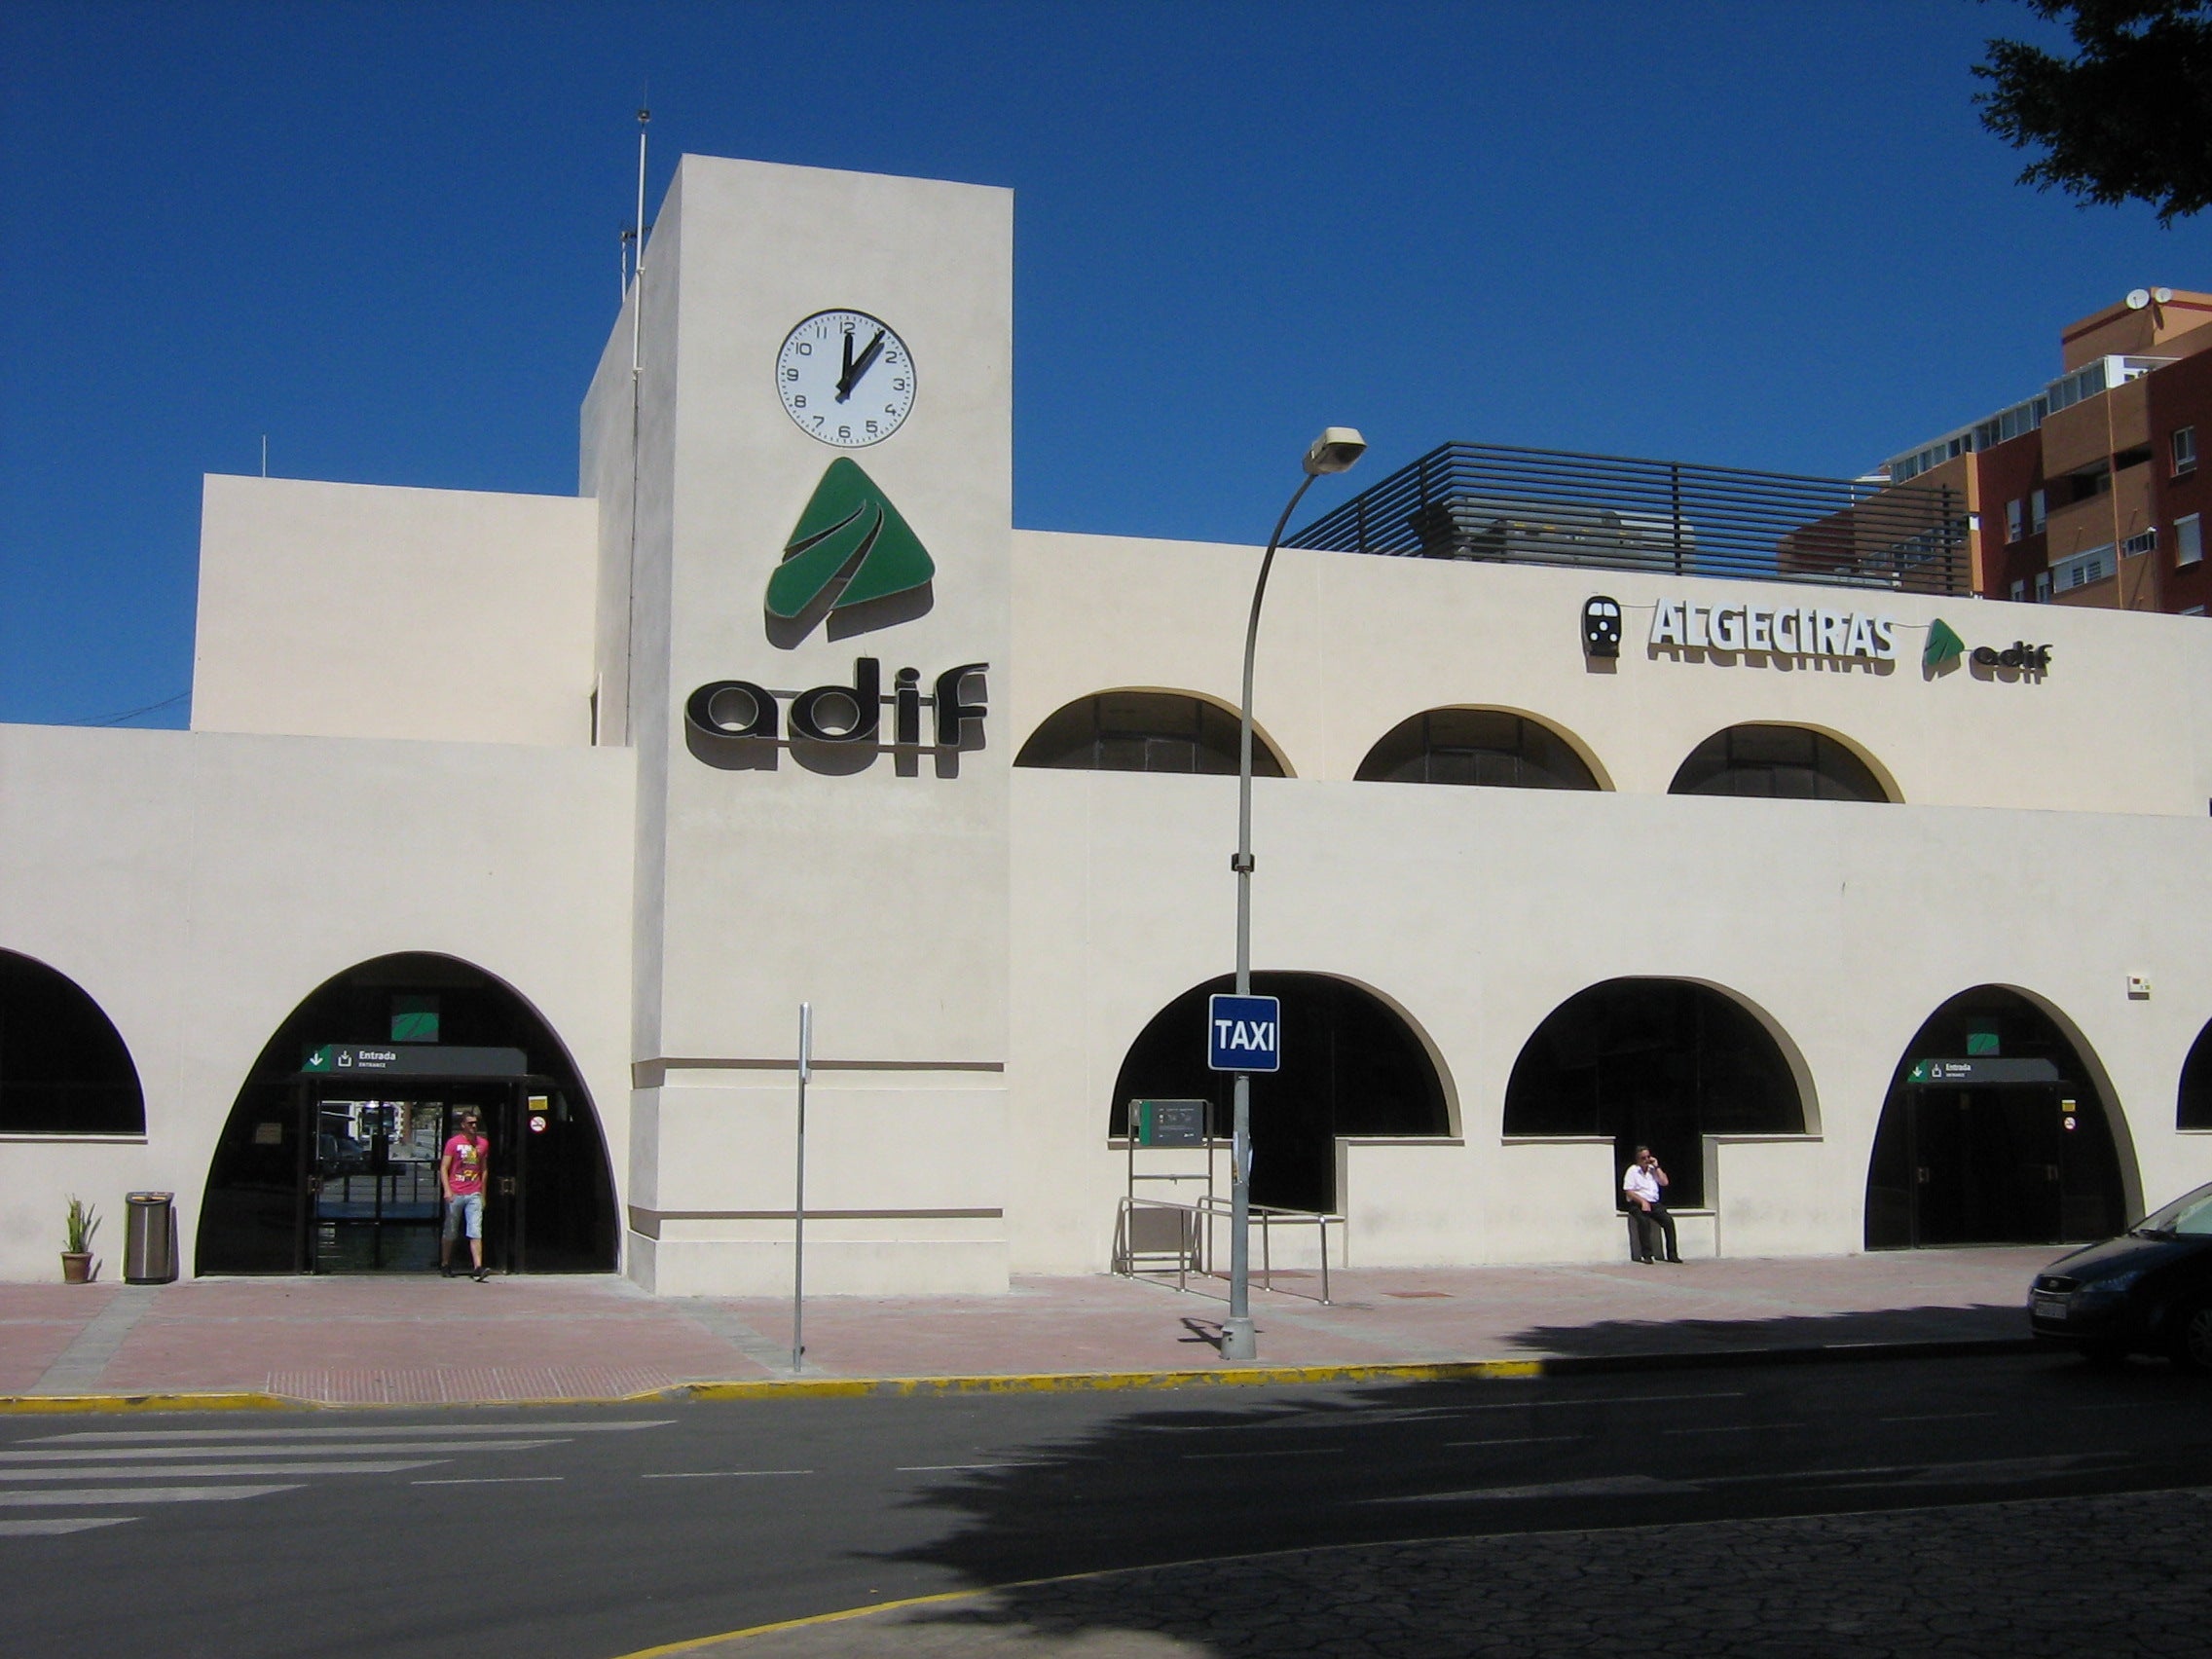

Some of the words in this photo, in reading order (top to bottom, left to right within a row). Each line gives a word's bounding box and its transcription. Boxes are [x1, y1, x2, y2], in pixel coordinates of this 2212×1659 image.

[816, 326, 827, 340] 11
[839, 321, 856, 335] 12
[795, 342, 812, 356] 10
[885, 350, 897, 364] 2
[787, 368, 799, 382] 9
[893, 378, 905, 391] 3
[794, 394, 806, 408] 8
[885, 404, 897, 416] 4
[813, 416, 825, 428] 7
[866, 421, 878, 433] 5
[838, 425, 851, 438] 6
[1649, 597, 1899, 661] ALGECIRAS
[1972, 641, 2053, 670] adif
[684, 657, 989, 748] adif
[1215, 1019, 1274, 1051] TAXI
[359, 1051, 396, 1060] Entrada
[1945, 1063, 1972, 1072] Entrada
